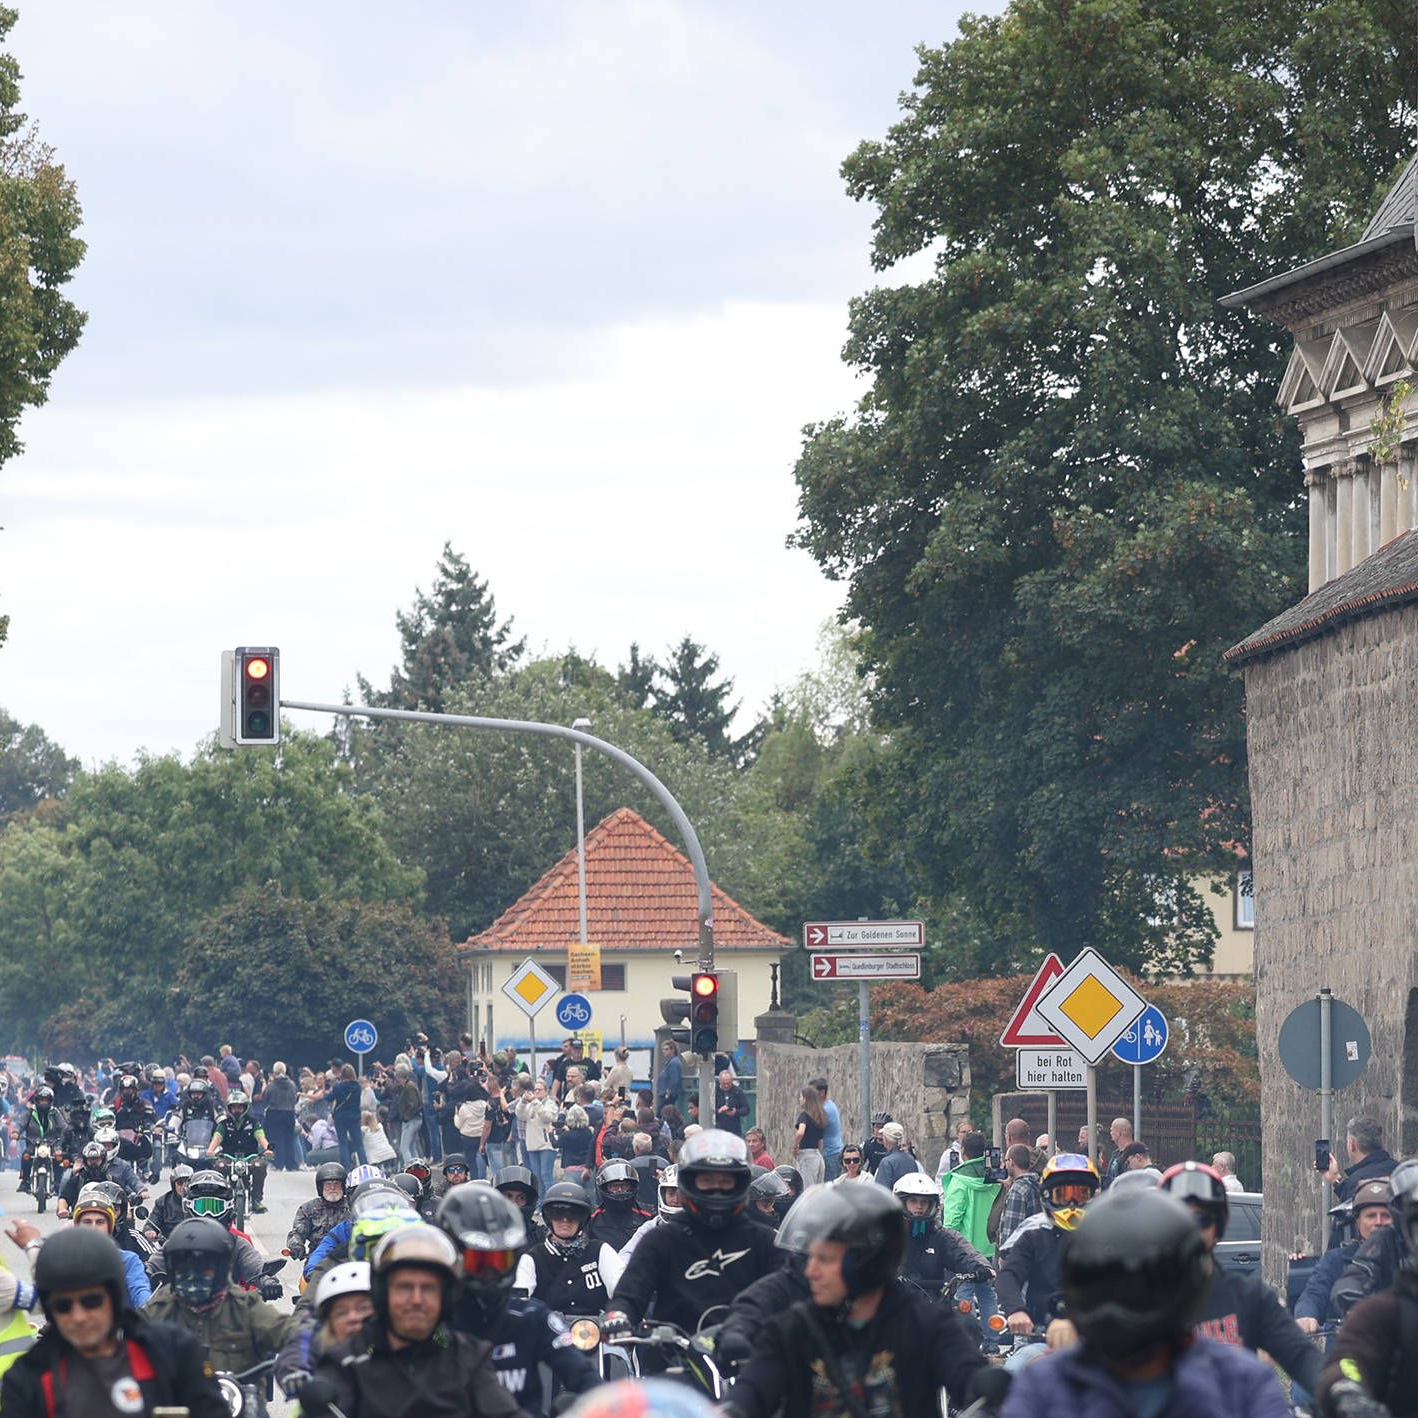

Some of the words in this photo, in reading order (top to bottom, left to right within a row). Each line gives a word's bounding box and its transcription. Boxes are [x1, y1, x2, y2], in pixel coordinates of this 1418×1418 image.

[846, 930, 858, 939] Zur
[861, 930, 893, 939] Goldenen
[896, 929, 917, 938] Sonne
[851, 963, 885, 971] Quedlinburger
[885, 962, 916, 970] Stadtschloss
[1037, 1055, 1052, 1067] bei
[1056, 1055, 1072, 1067] Rot
[1027, 1070, 1047, 1082] hier
[1051, 1070, 1082, 1082] halten
[585, 1271, 603, 1289] 01
